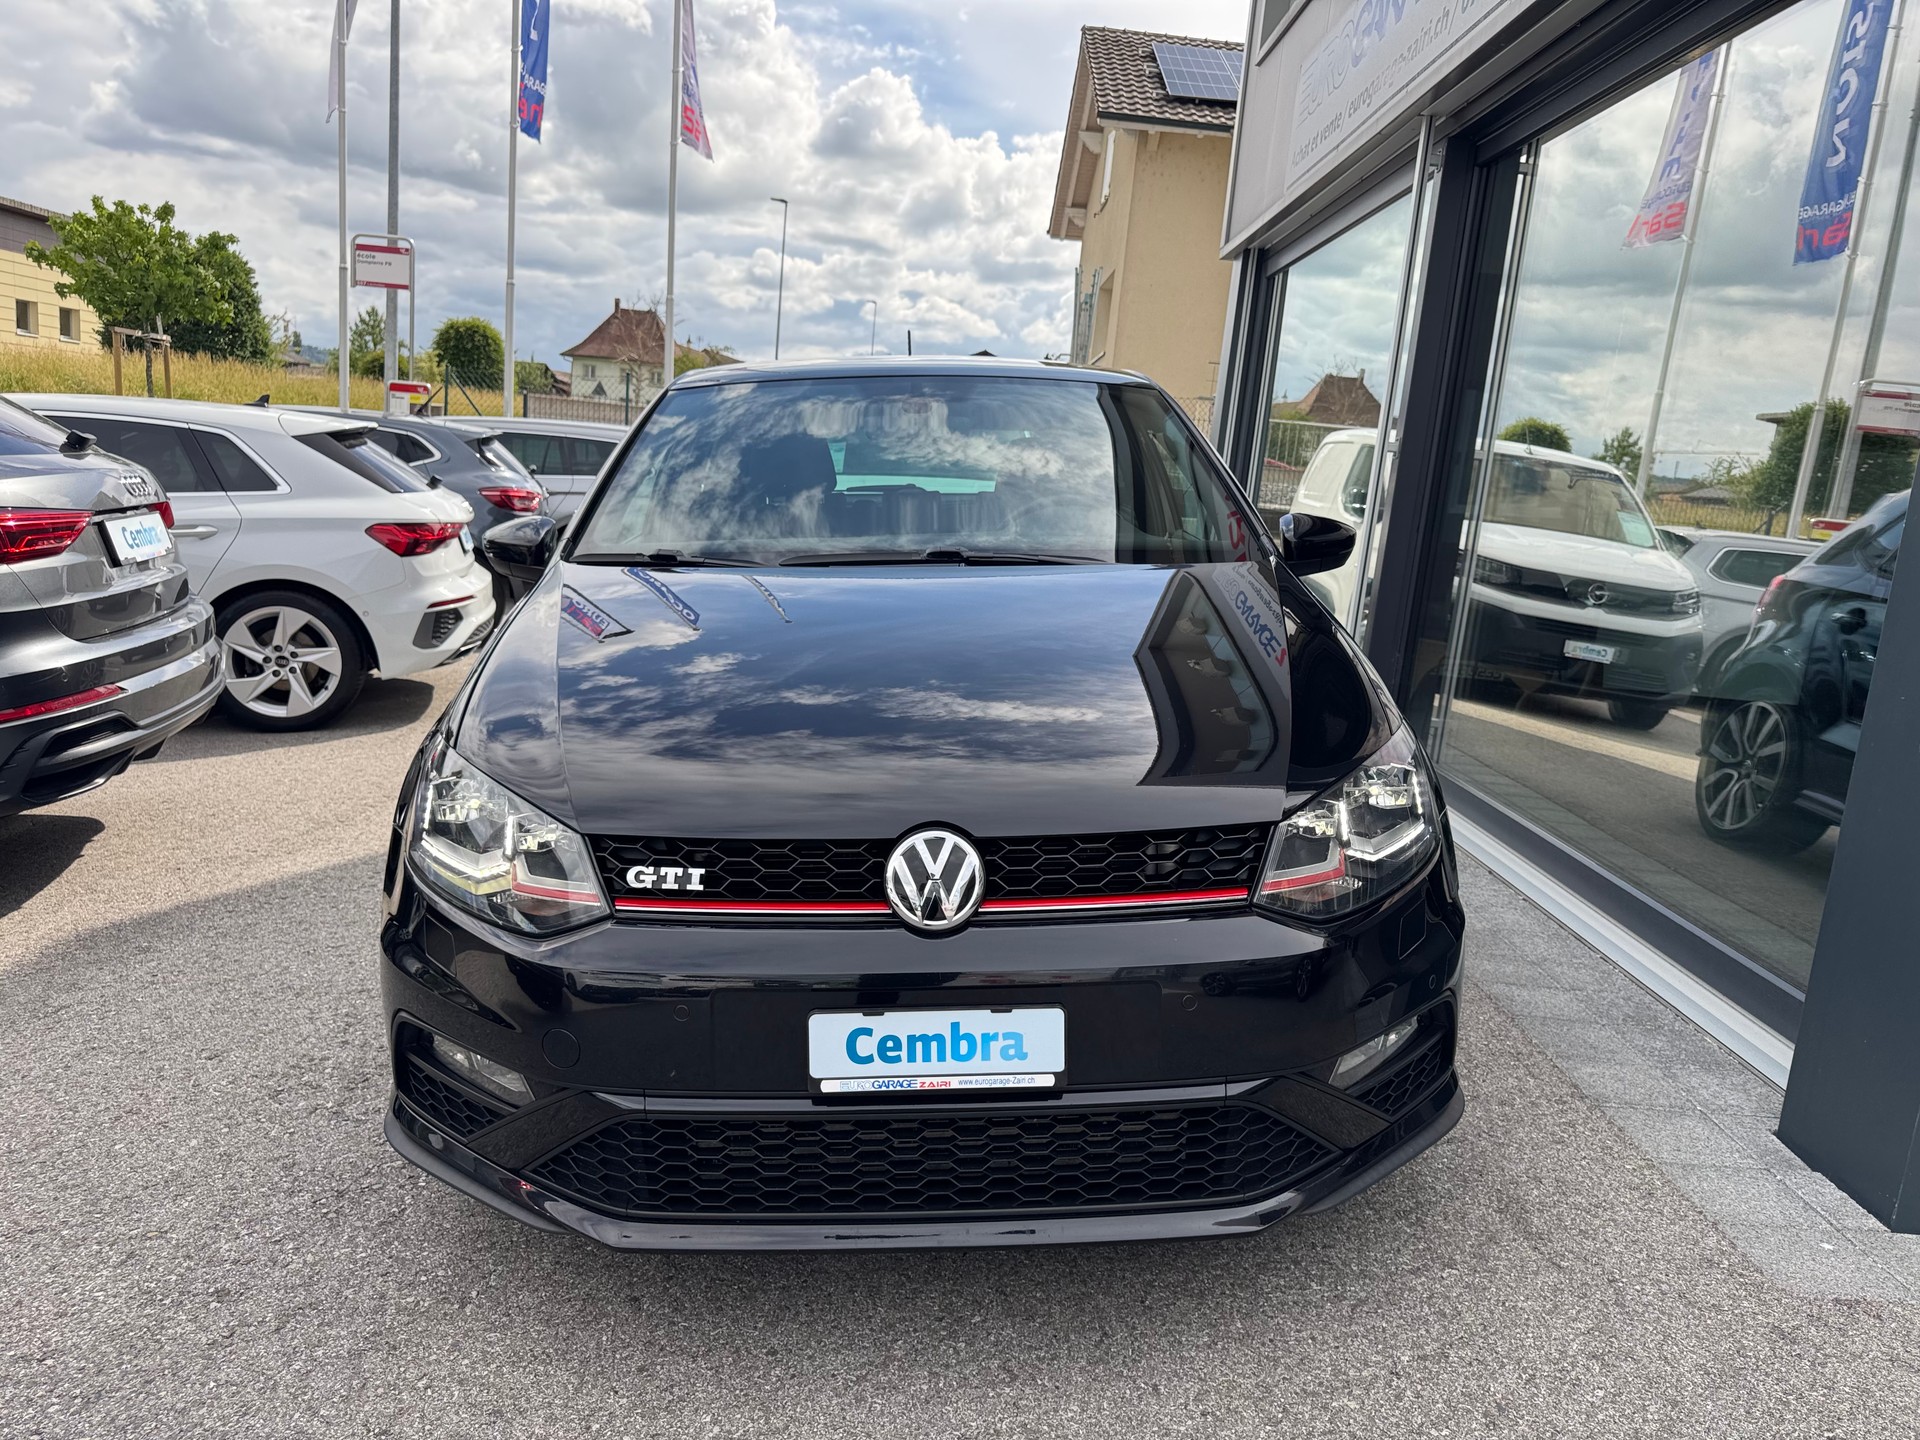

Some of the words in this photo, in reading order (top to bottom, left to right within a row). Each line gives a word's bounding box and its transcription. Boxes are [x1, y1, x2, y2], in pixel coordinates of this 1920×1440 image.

[626, 866, 706, 891] GTI
[845, 1021, 1029, 1065] Cembra
[919, 1081, 951, 1089] ZAIRI
[958, 1076, 1036, 1088] www.eurogarage-Zairi.ch
